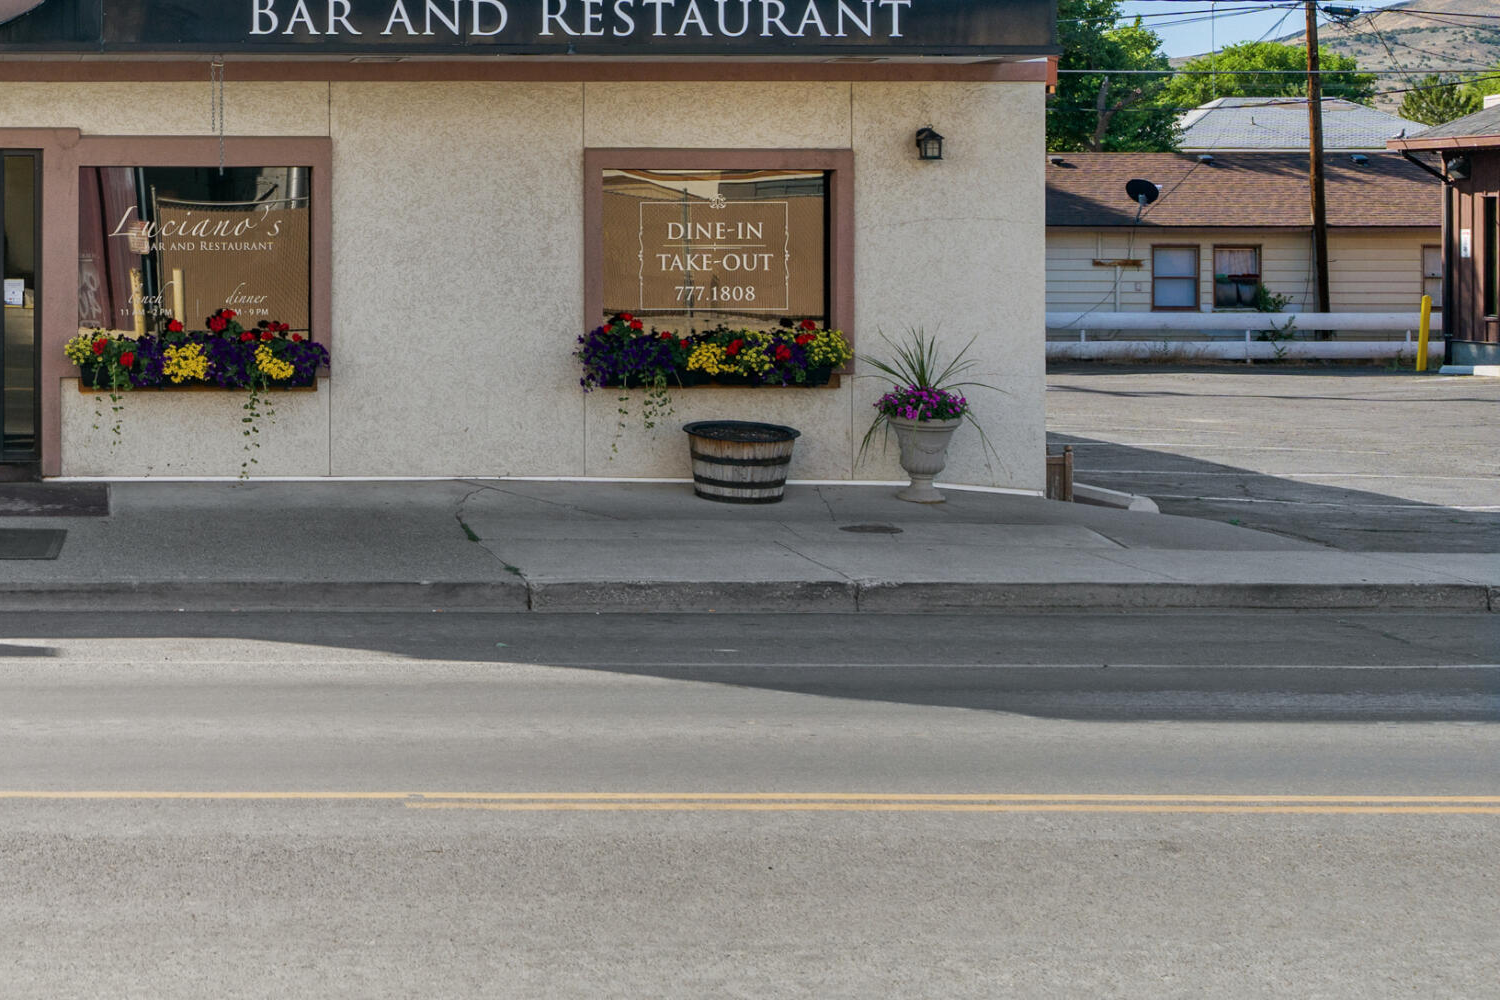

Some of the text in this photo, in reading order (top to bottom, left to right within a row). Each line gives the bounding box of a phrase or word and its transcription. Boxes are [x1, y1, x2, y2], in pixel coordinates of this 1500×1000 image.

[108, 205, 283, 237] Luciano's
[667, 222, 763, 240] DINE-IN
[170, 242, 195, 250] AND
[200, 241, 274, 251] RESTAURANT
[656, 254, 774, 271] TAKE-OUT
[225, 282, 268, 305] dinner
[674, 286, 756, 301] 777.1808
[256, 308, 269, 316] PM
